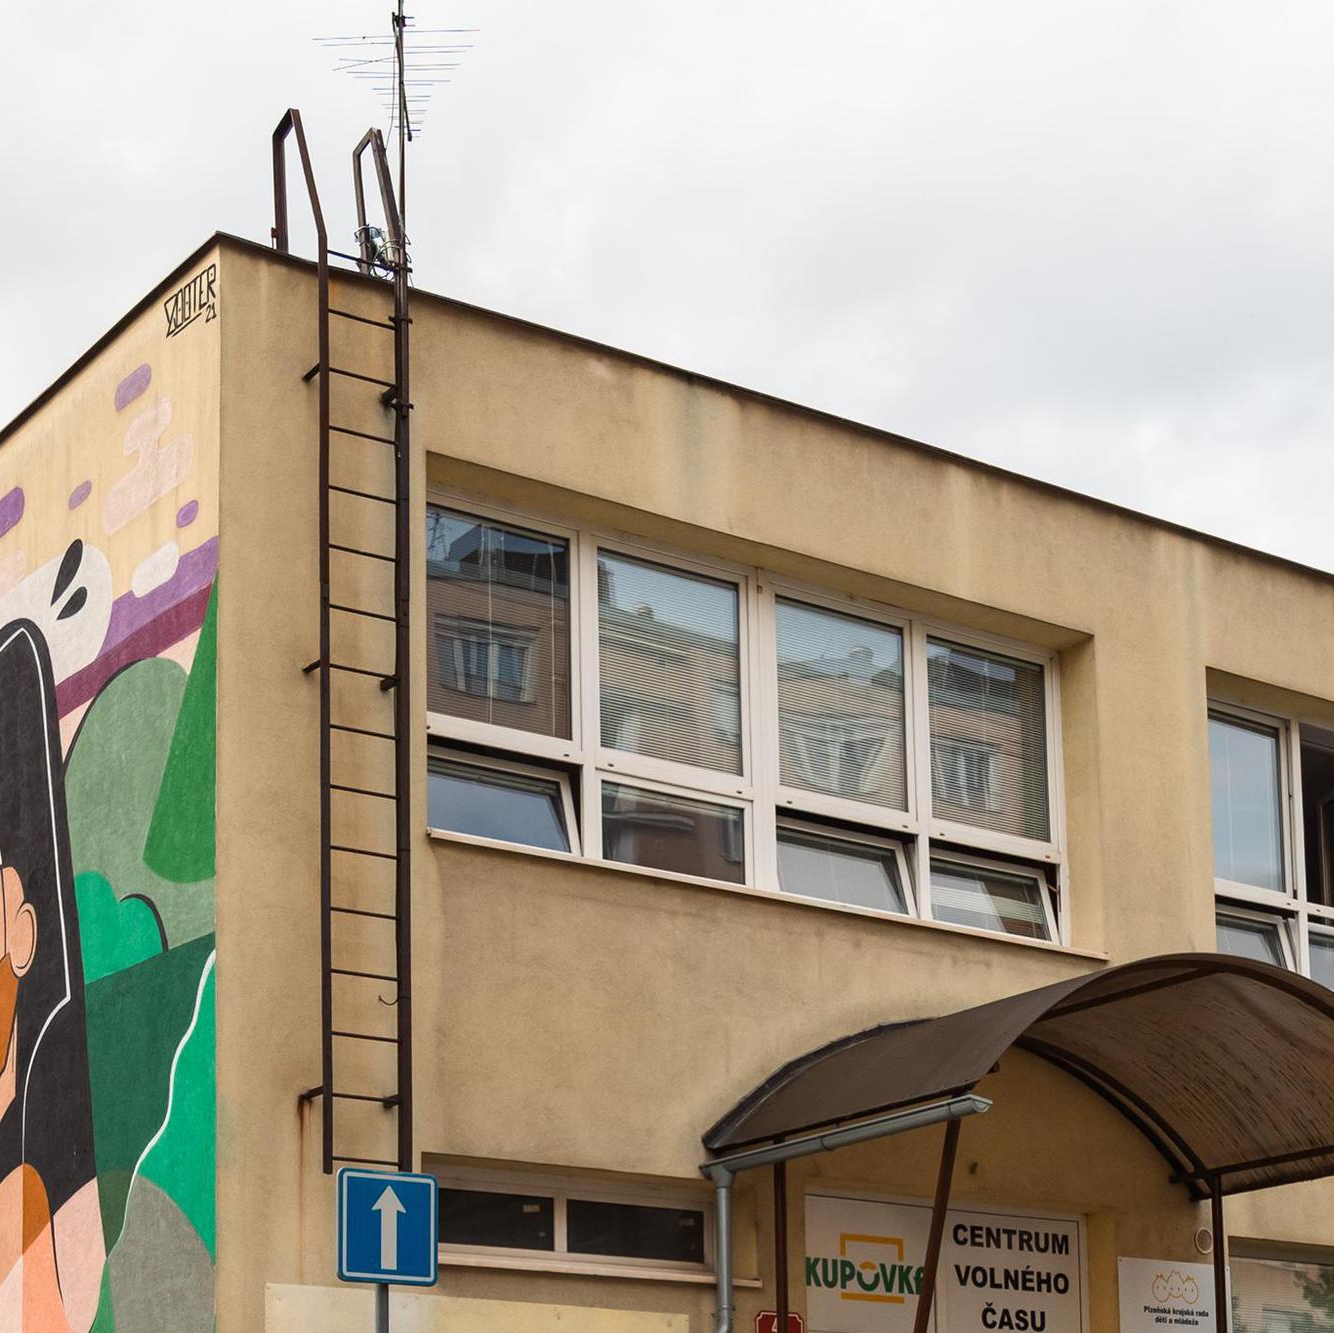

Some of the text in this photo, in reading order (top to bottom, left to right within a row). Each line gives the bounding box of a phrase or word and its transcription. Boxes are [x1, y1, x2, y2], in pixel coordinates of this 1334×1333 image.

[205, 302, 217, 323] 21
[953, 1224, 1069, 1255] CENTRUM
[955, 1265, 1069, 1295] VOLNÉHO
[981, 1303, 1046, 1332] ČASU
[1172, 1307, 1194, 1317] krajská
